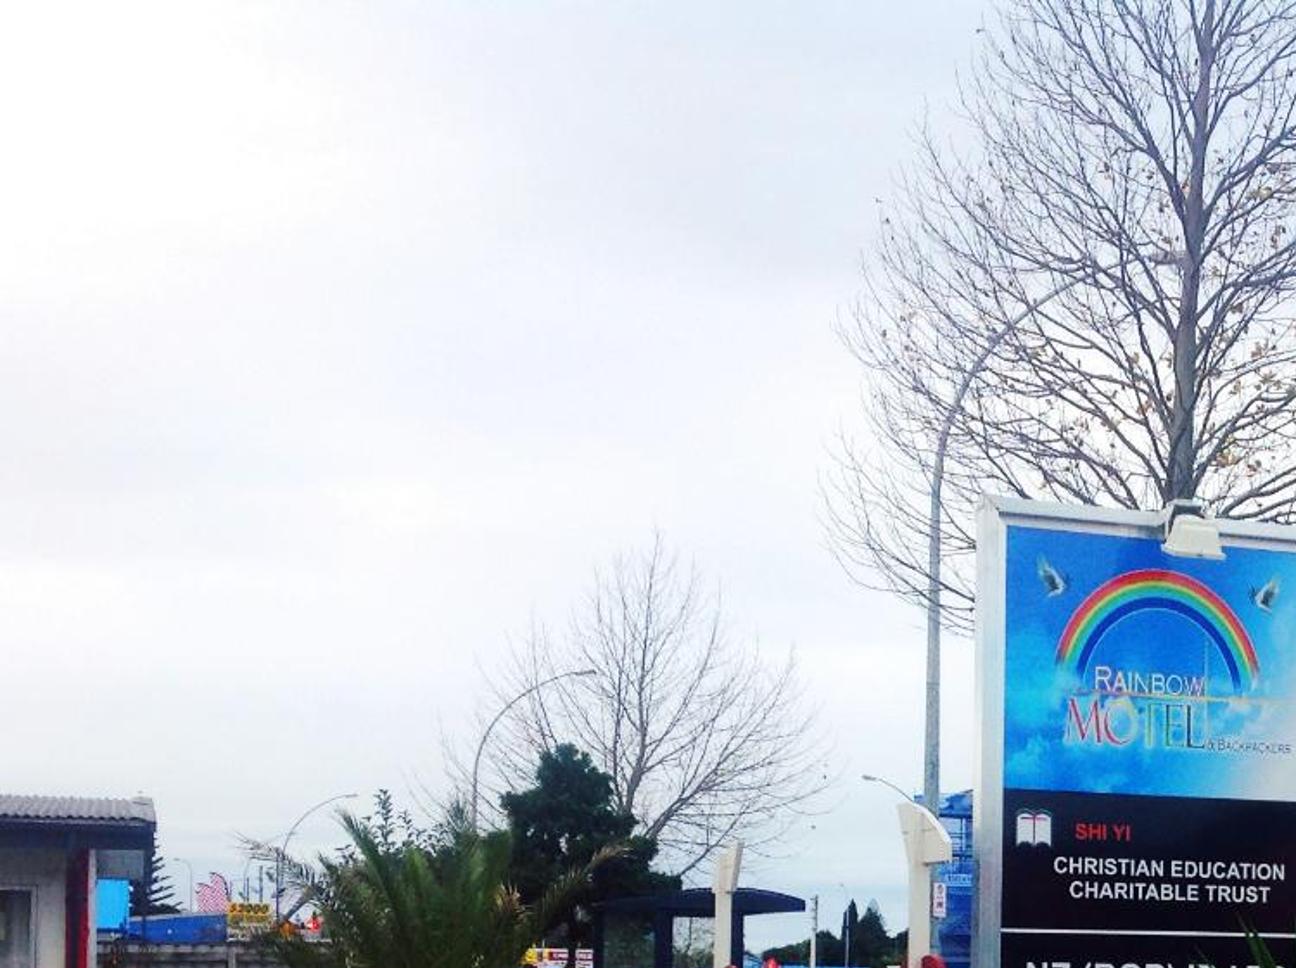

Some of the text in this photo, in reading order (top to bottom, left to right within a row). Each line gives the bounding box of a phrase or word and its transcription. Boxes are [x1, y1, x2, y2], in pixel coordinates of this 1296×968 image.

[1094, 665, 1206, 697] RAINBOW
[1065, 695, 1206, 750] MOTEL
[1217, 740, 1292, 755] BACKPACKERS
[1075, 823, 1131, 842] SHI YI
[1053, 856, 1286, 881] CHRISTIAN EDUCATION
[1069, 880, 1271, 904] CHARITABLE TRUST
